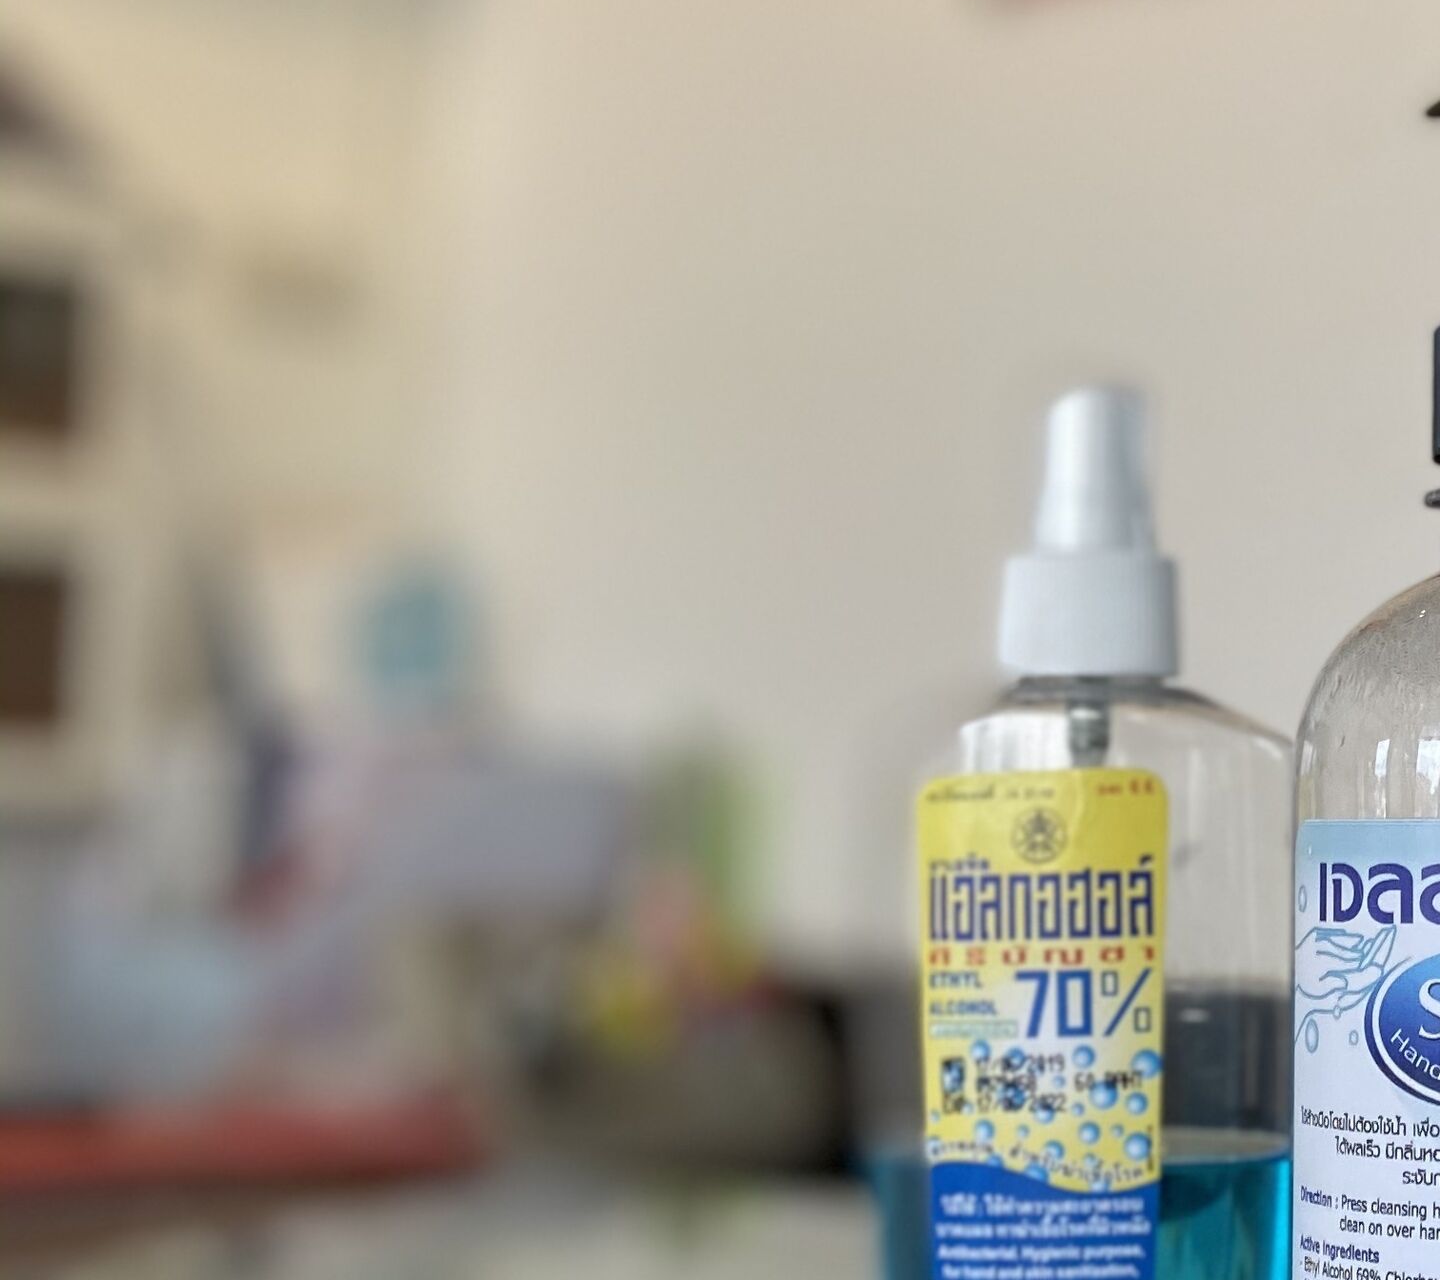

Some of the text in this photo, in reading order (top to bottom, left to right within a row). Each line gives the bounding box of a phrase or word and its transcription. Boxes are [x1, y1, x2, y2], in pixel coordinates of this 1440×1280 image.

[929, 854, 1156, 942] แอลกอฮอล์
[929, 967, 1153, 1039] ETHYL 70%
[929, 1000, 999, 1017] ALCOHOL
[1334, 1135, 1381, 1159] ได้ผลเร็ว
[1300, 1186, 1333, 1209] Direction
[1341, 1193, 1368, 1213] Press
[1371, 1197, 1428, 1222] cleansing
[1339, 1216, 1365, 1233] clean
[1368, 1220, 1383, 1236] on
[1386, 1224, 1416, 1239] over
[1299, 1234, 1321, 1255] Active
[1304, 1255, 1320, 1278] Ethyl
